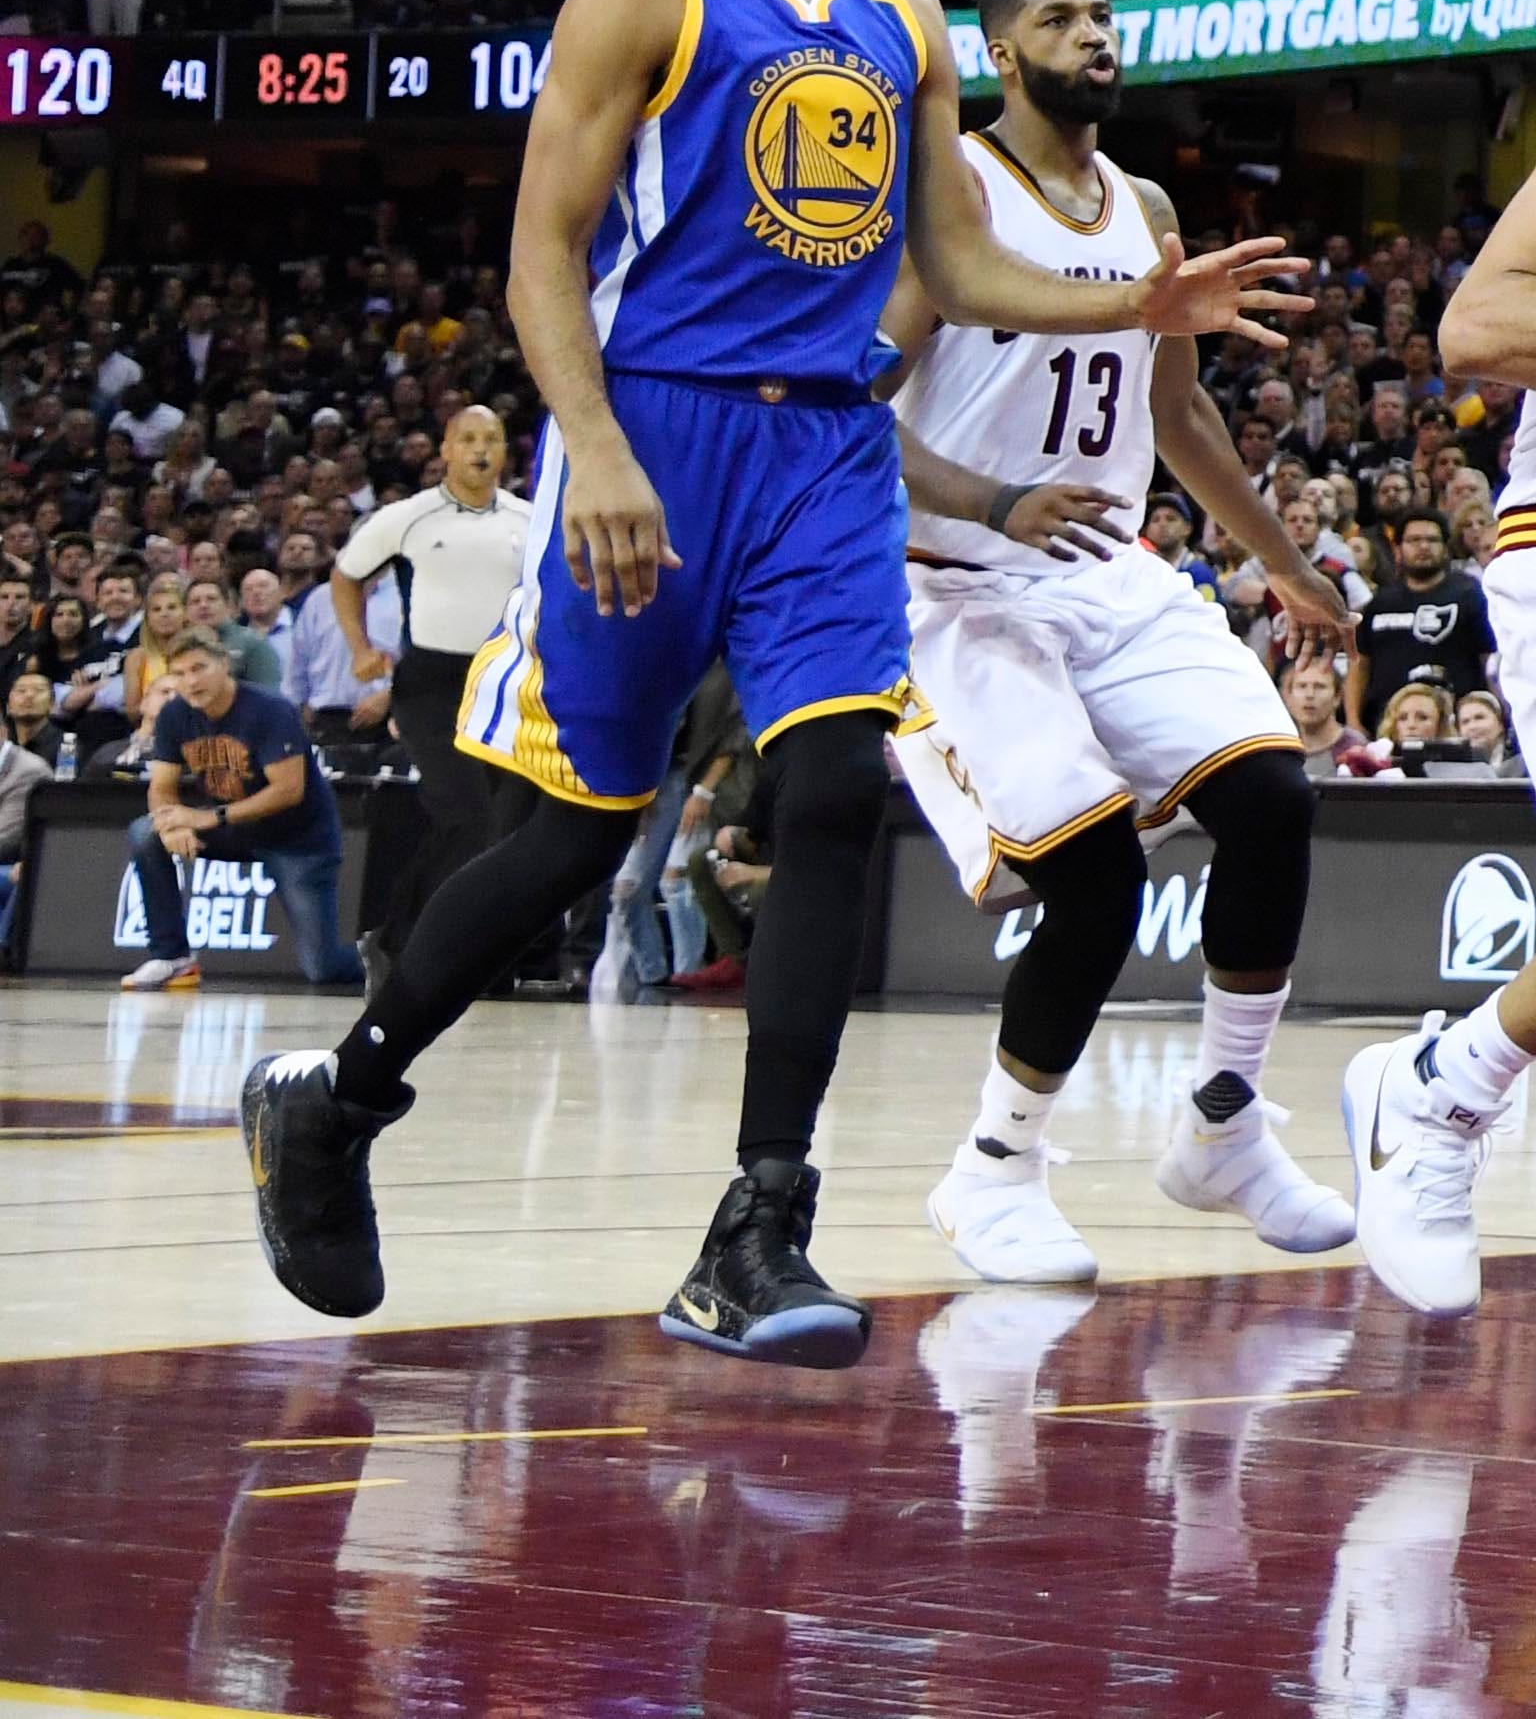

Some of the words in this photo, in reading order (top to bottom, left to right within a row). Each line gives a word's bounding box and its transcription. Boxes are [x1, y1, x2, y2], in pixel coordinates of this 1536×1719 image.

[7, 48, 112, 115] 120
[162, 59, 207, 100] 4Q
[258, 52, 349, 104] 8:25
[389, 56, 429, 98] 20
[748, 48, 836, 100] GOLDEN
[845, 54, 902, 110] STATE
[828, 107, 878, 152] 34
[743, 199, 895, 267] WARRIORS
[1042, 347, 1122, 458] 13
[187, 897, 279, 950] BELL
